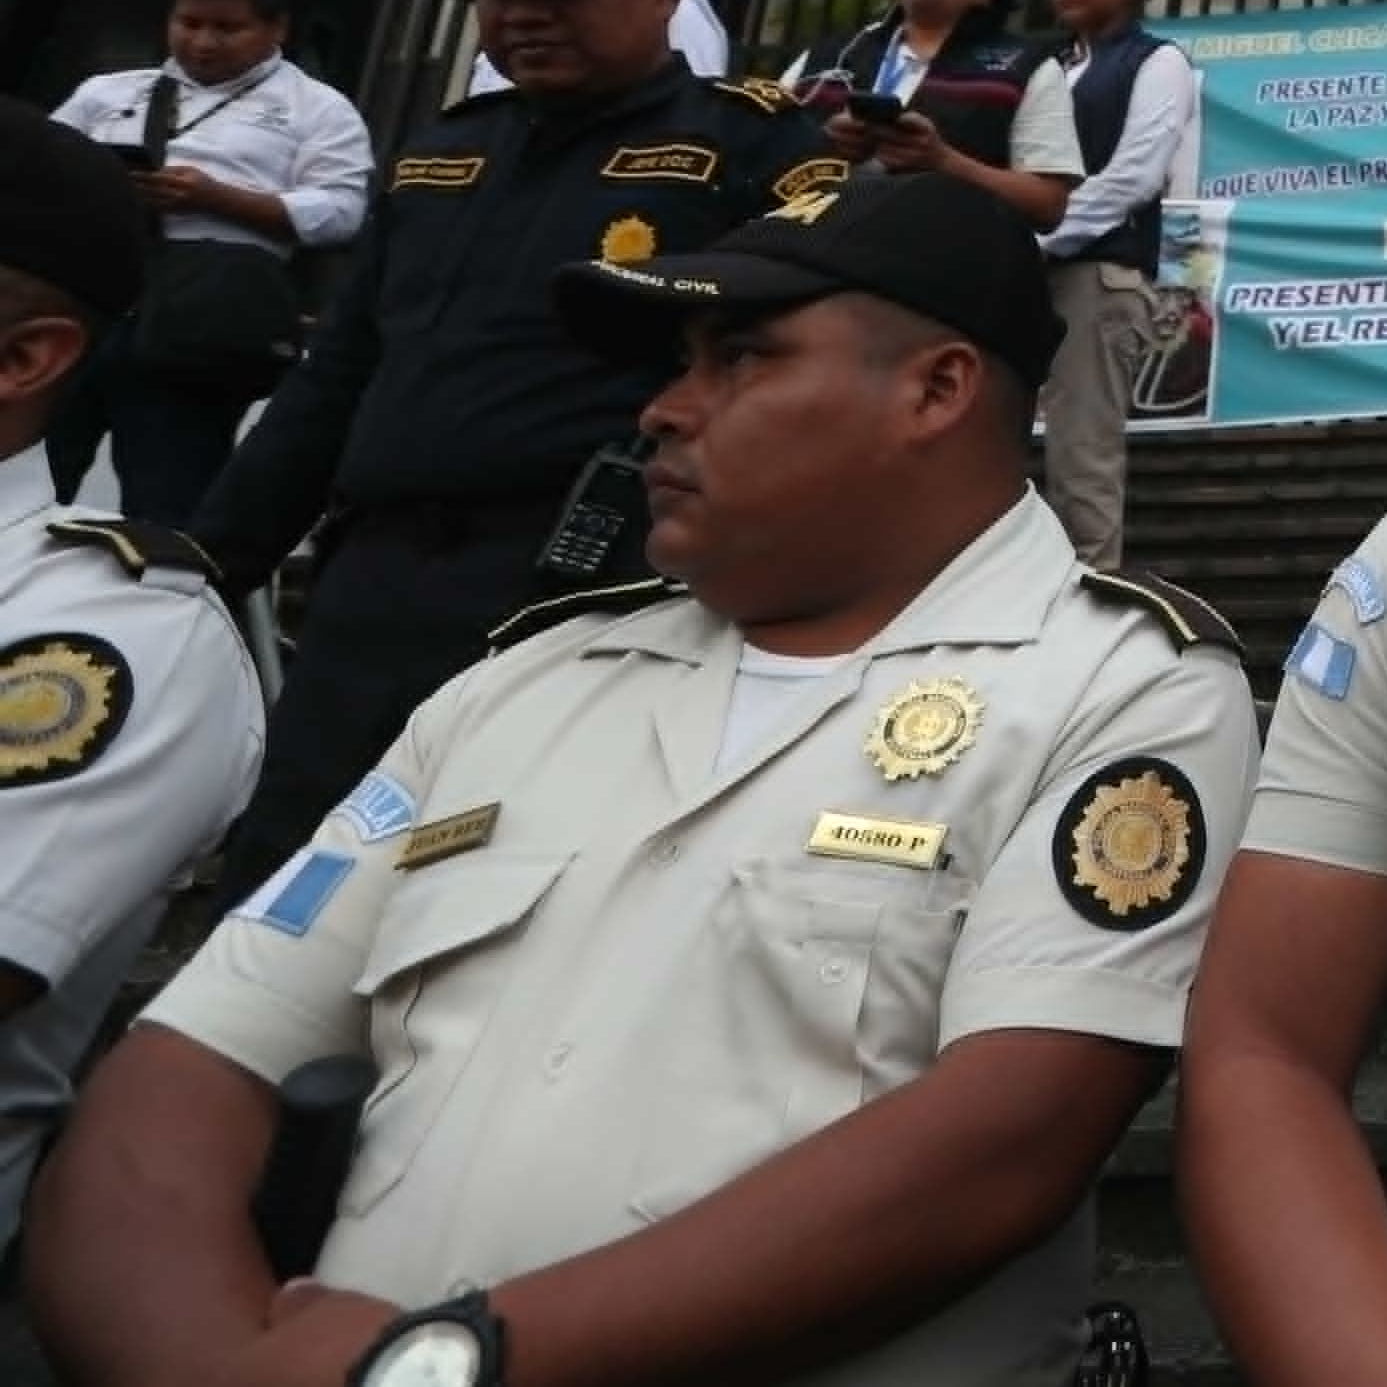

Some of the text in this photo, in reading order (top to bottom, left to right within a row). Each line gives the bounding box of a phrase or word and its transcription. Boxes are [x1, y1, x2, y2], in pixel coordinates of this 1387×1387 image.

[1259, 75, 1385, 102] PRESENTE
[1289, 109, 1321, 129] LA
[1263, 166, 1317, 193] VIVA
[1326, 164, 1353, 186] EL
